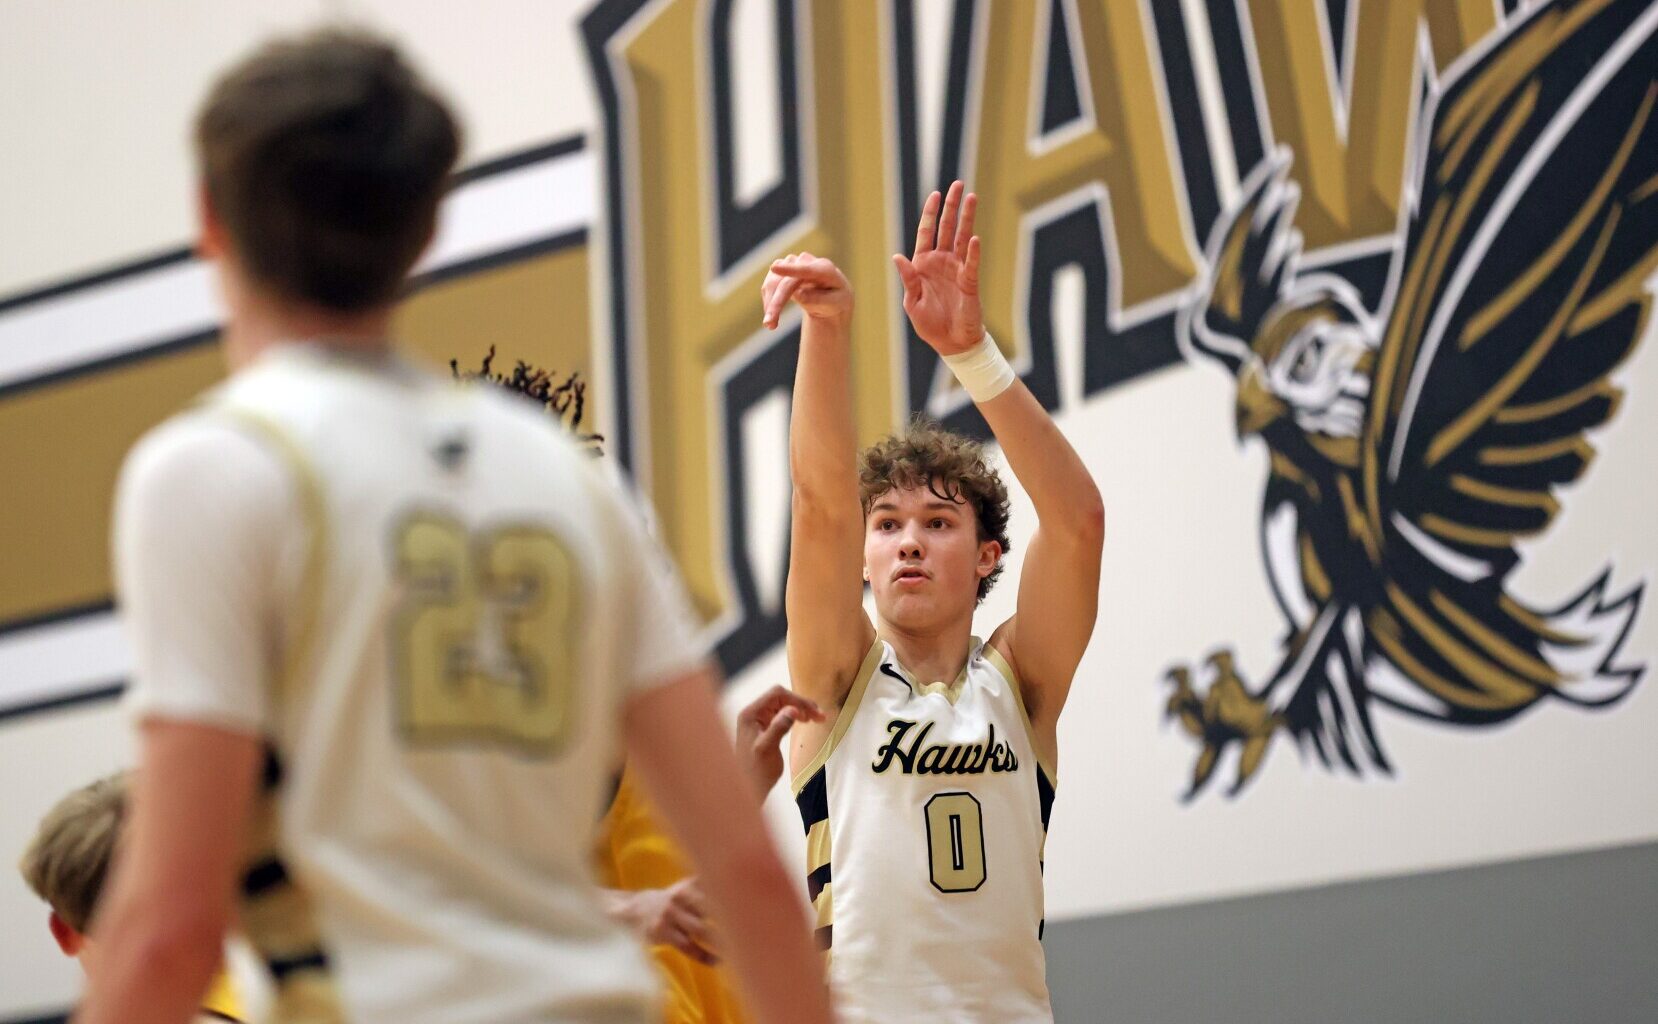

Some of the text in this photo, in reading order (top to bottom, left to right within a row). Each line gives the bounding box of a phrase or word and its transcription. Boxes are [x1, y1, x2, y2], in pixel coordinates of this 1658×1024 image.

[389, 507, 583, 757] 23
[871, 719, 1019, 775] Hawks
[923, 791, 987, 894] 0
